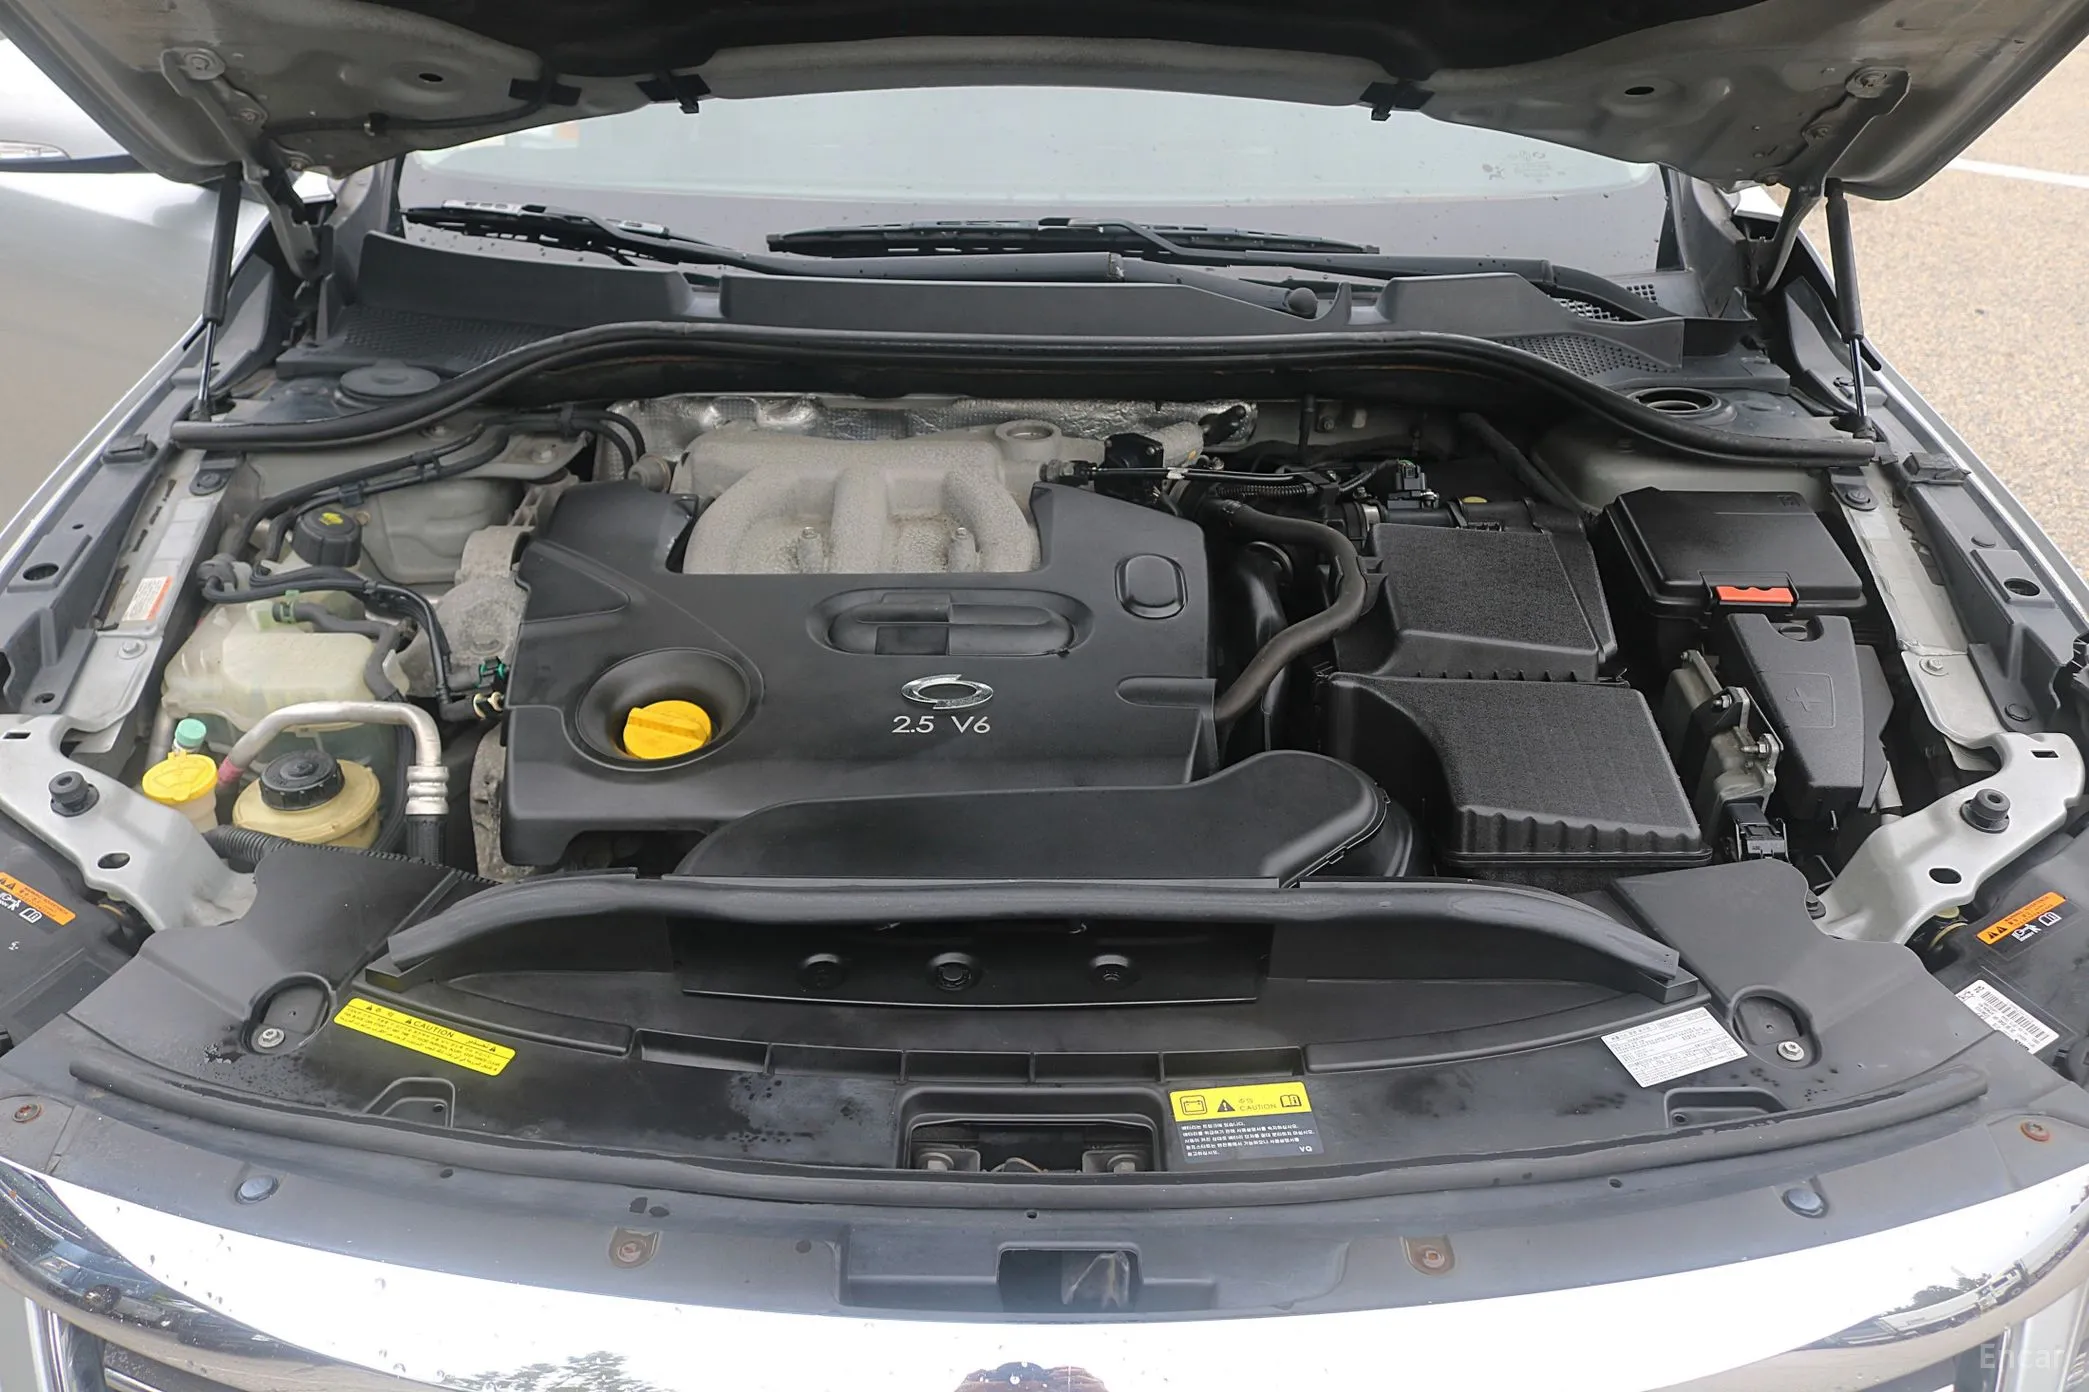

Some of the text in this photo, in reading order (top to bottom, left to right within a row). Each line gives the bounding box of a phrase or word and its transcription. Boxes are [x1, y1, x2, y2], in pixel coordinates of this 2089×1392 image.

[892, 716, 991, 733] 2.5 V6
[413, 1020, 454, 1038] CAUTION
[1239, 1103, 1276, 1111] CAUTION
